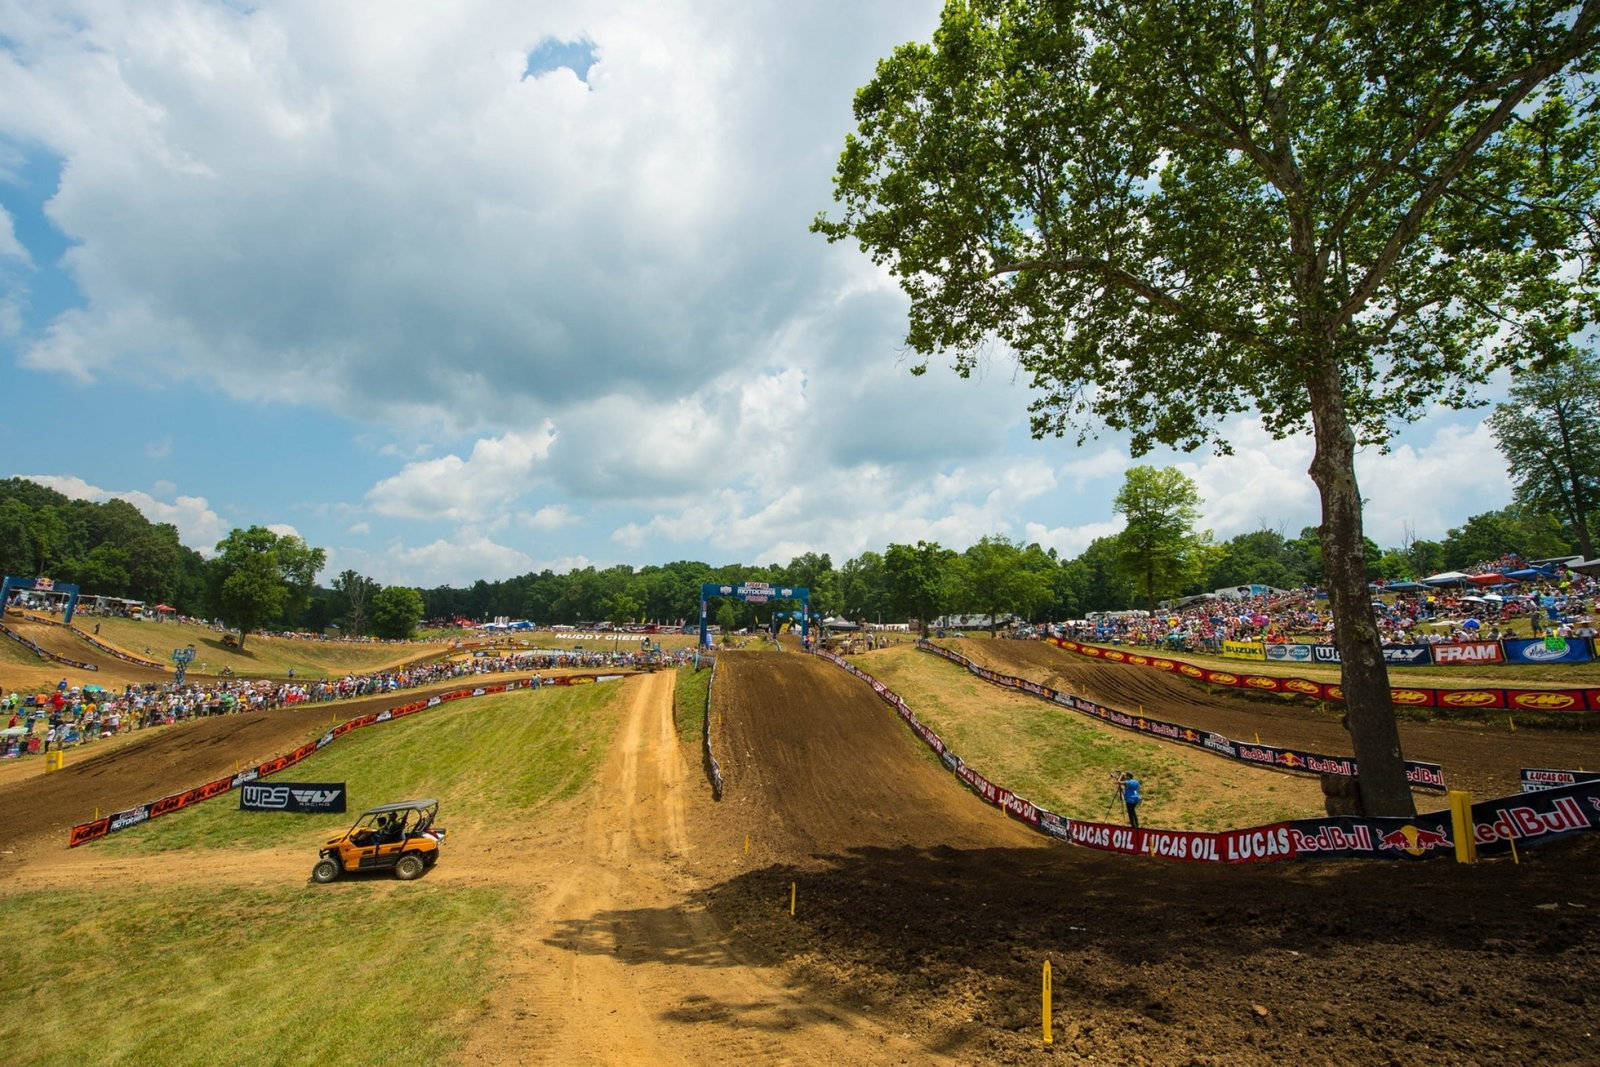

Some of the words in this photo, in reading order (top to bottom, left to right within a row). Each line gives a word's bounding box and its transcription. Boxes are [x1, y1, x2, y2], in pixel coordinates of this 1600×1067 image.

[1225, 645, 1262, 655] SUZUKI
[1435, 645, 1496, 662] FRAM
[1445, 692, 1495, 704] FMF
[1516, 694, 1573, 706] FMF
[1530, 772, 1556, 781] LUCAS
[1557, 773, 1572, 782] OIL
[243, 785, 290, 808] WPS
[290, 790, 342, 803] FLY
[999, 789, 1023, 814] LUCAS
[1023, 803, 1038, 822] OIL
[1072, 823, 1110, 848] LUCAS
[1112, 829, 1134, 850] OIL
[1141, 832, 1188, 859] LUCAS
[1191, 837, 1220, 861] OIL
[1228, 827, 1291, 861] LUCAS
